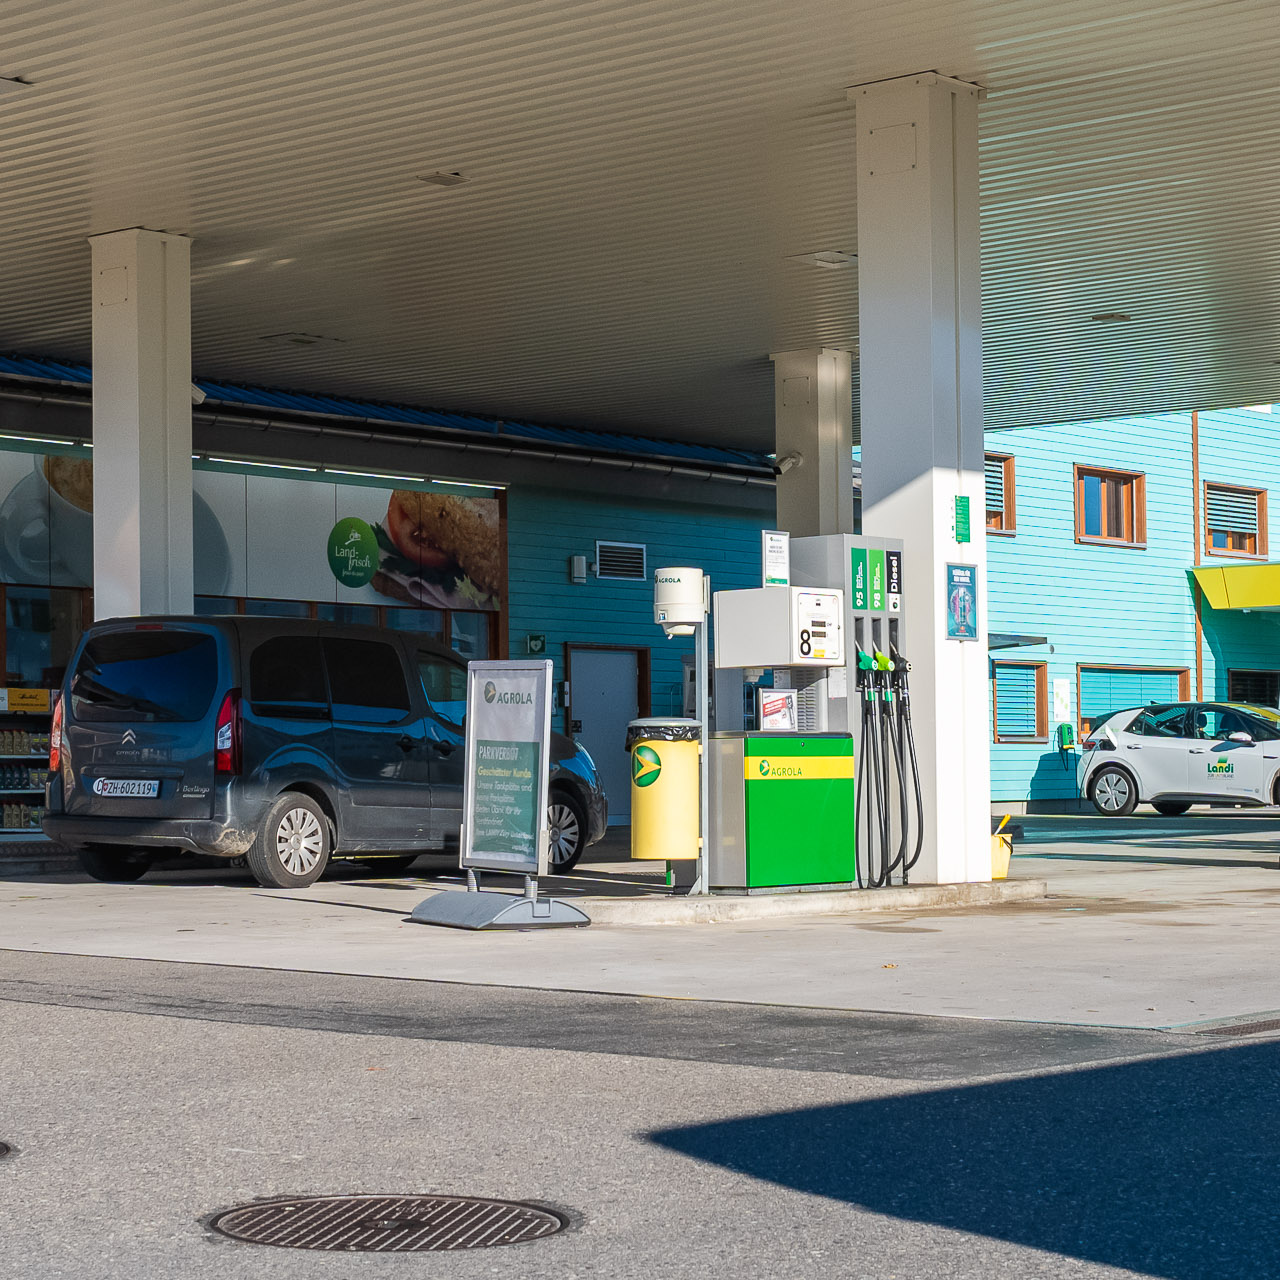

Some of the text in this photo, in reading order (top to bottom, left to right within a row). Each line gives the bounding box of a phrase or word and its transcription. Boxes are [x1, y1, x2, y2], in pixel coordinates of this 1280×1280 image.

[335, 545, 359, 558] Land-
[889, 556, 898, 593] Diesel
[856, 591, 864, 607] 95
[873, 592, 881, 608] 98
[800, 628, 812, 656] 8
[496, 692, 533, 705] AGROLA
[771, 767, 803, 776] AGROLA
[1207, 763, 1234, 774] Landi
